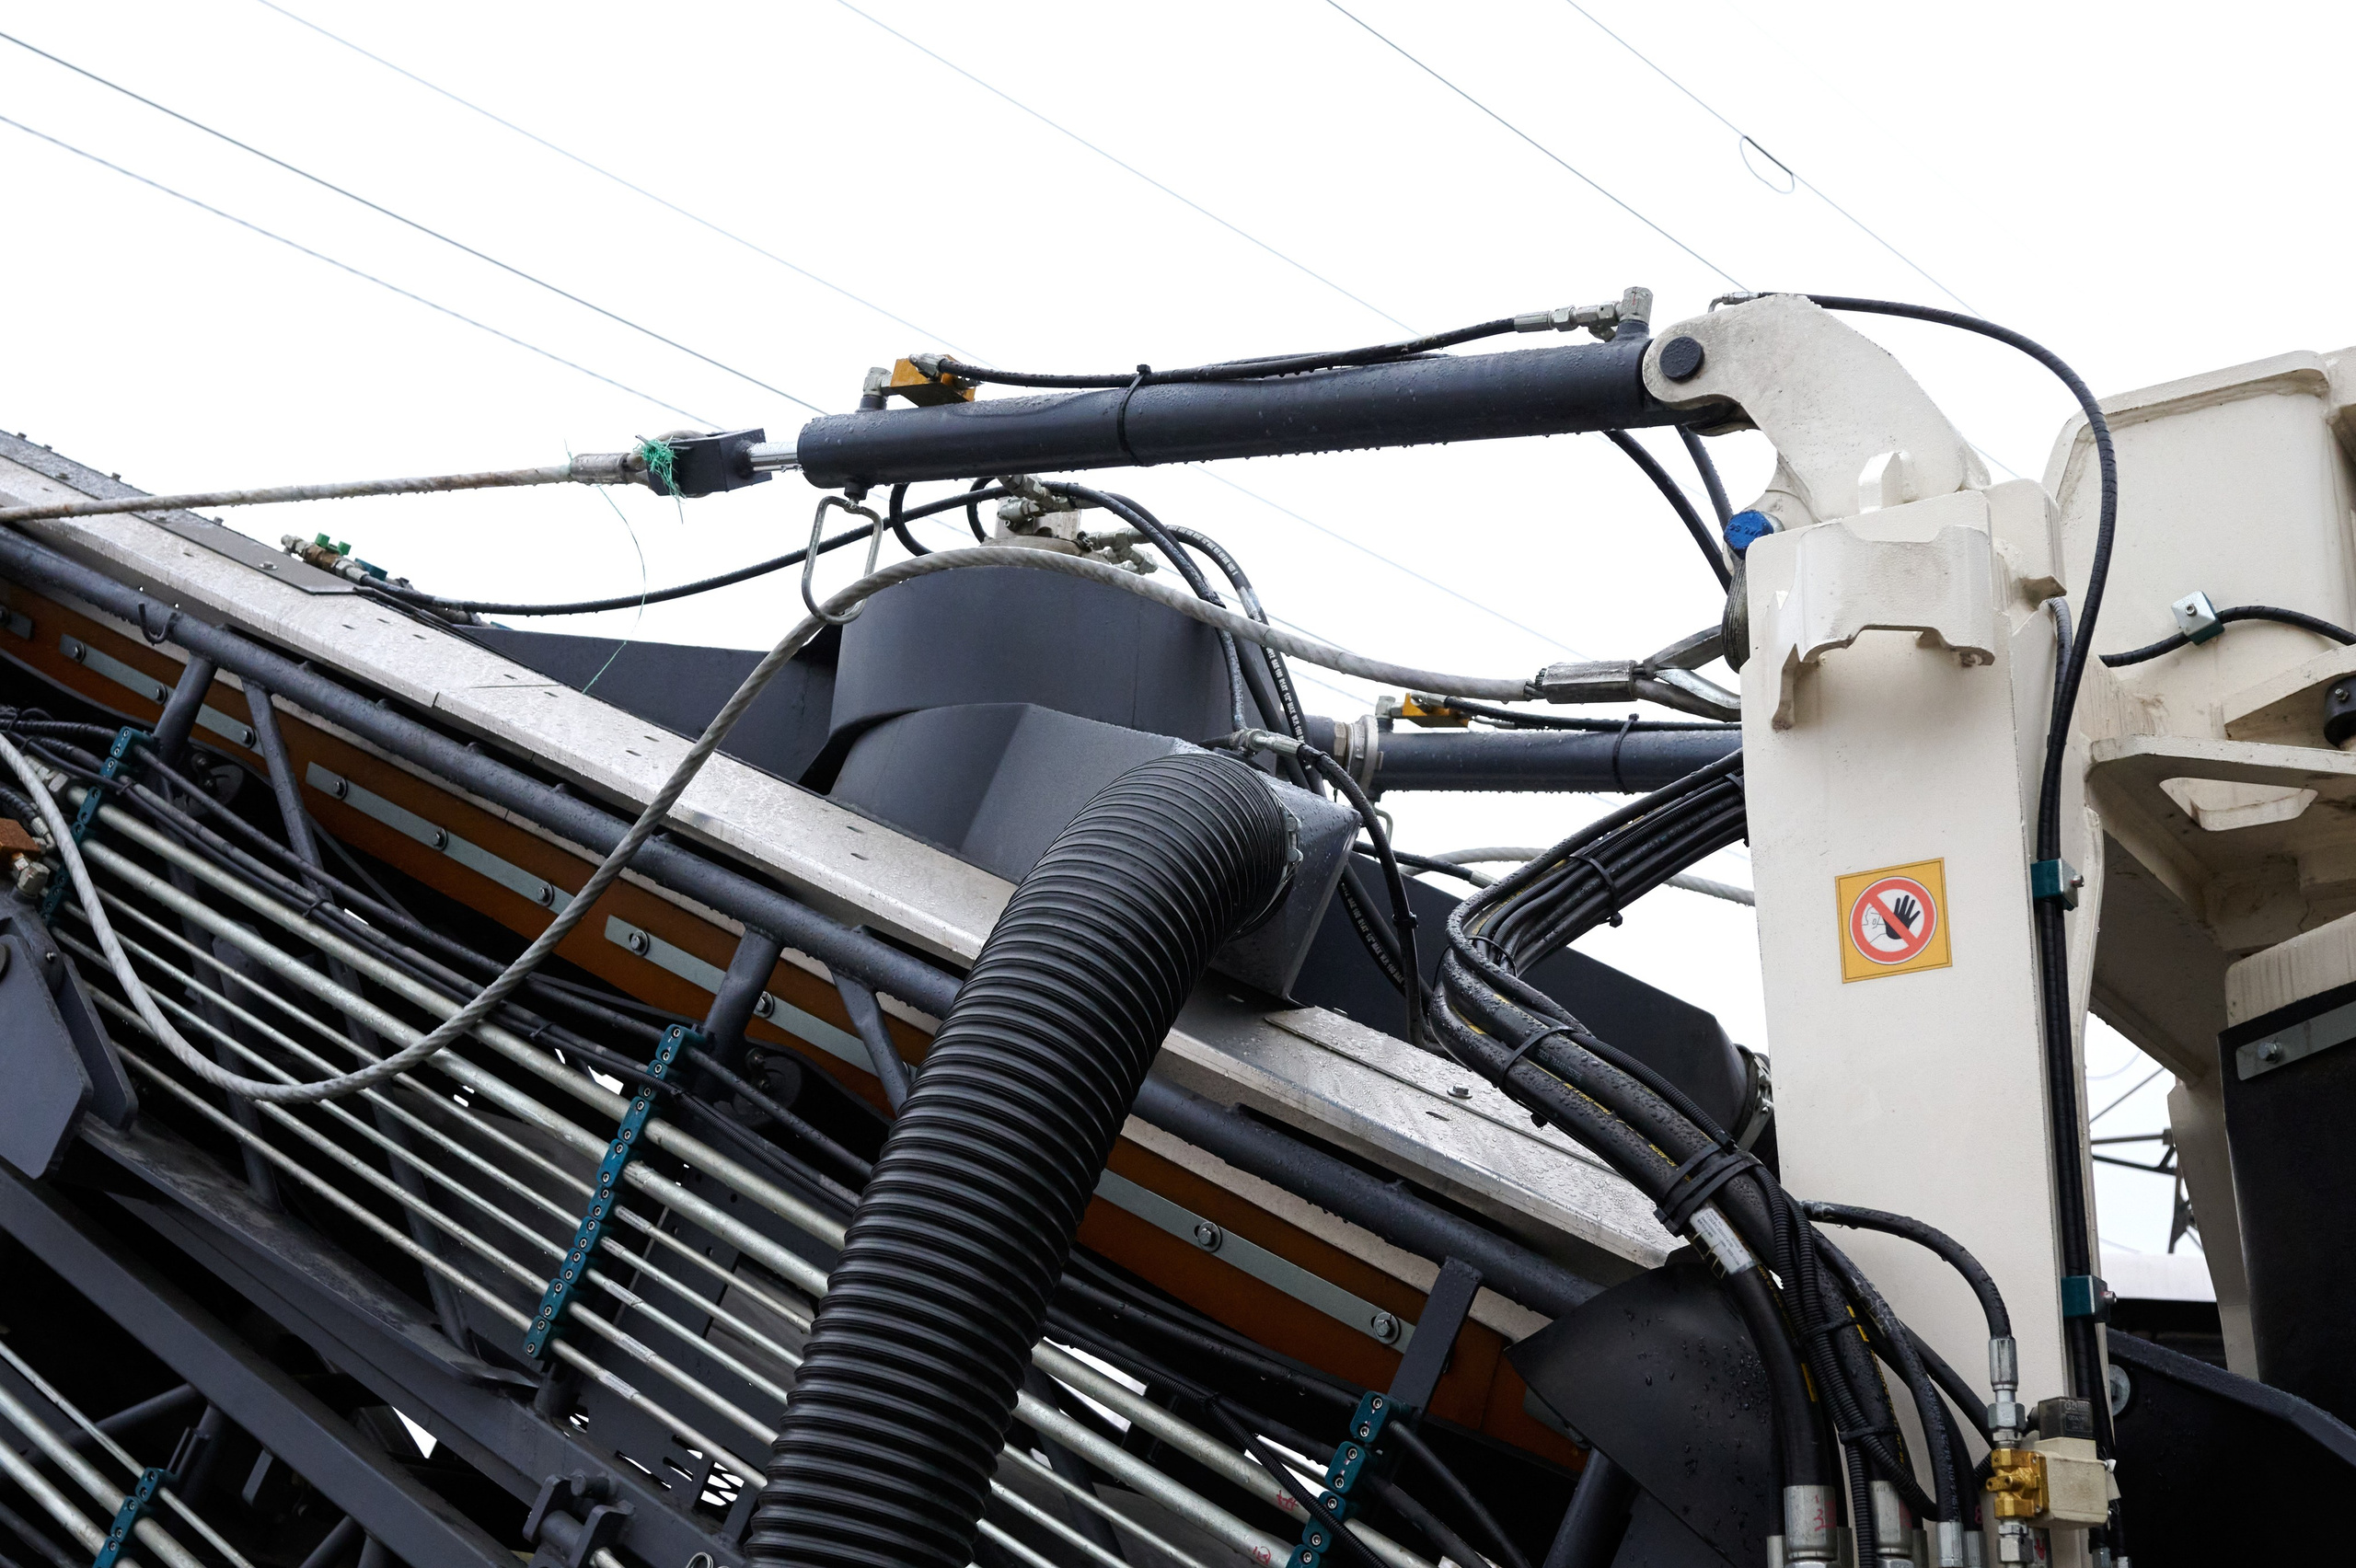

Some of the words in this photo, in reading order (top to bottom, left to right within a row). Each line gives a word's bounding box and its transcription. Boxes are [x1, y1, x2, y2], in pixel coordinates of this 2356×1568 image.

[1271, 660, 1280, 670] SAE
[1275, 668, 1283, 678] 100
[1288, 701, 1296, 714] MAX
[1347, 897, 1357, 909] SAE
[1353, 908, 1361, 918] 100
[1357, 918, 1369, 932] R1AT
[1366, 933, 1375, 942] 1/2"
[1371, 942, 1382, 955] MAX
[1393, 972, 1404, 984] BAR
